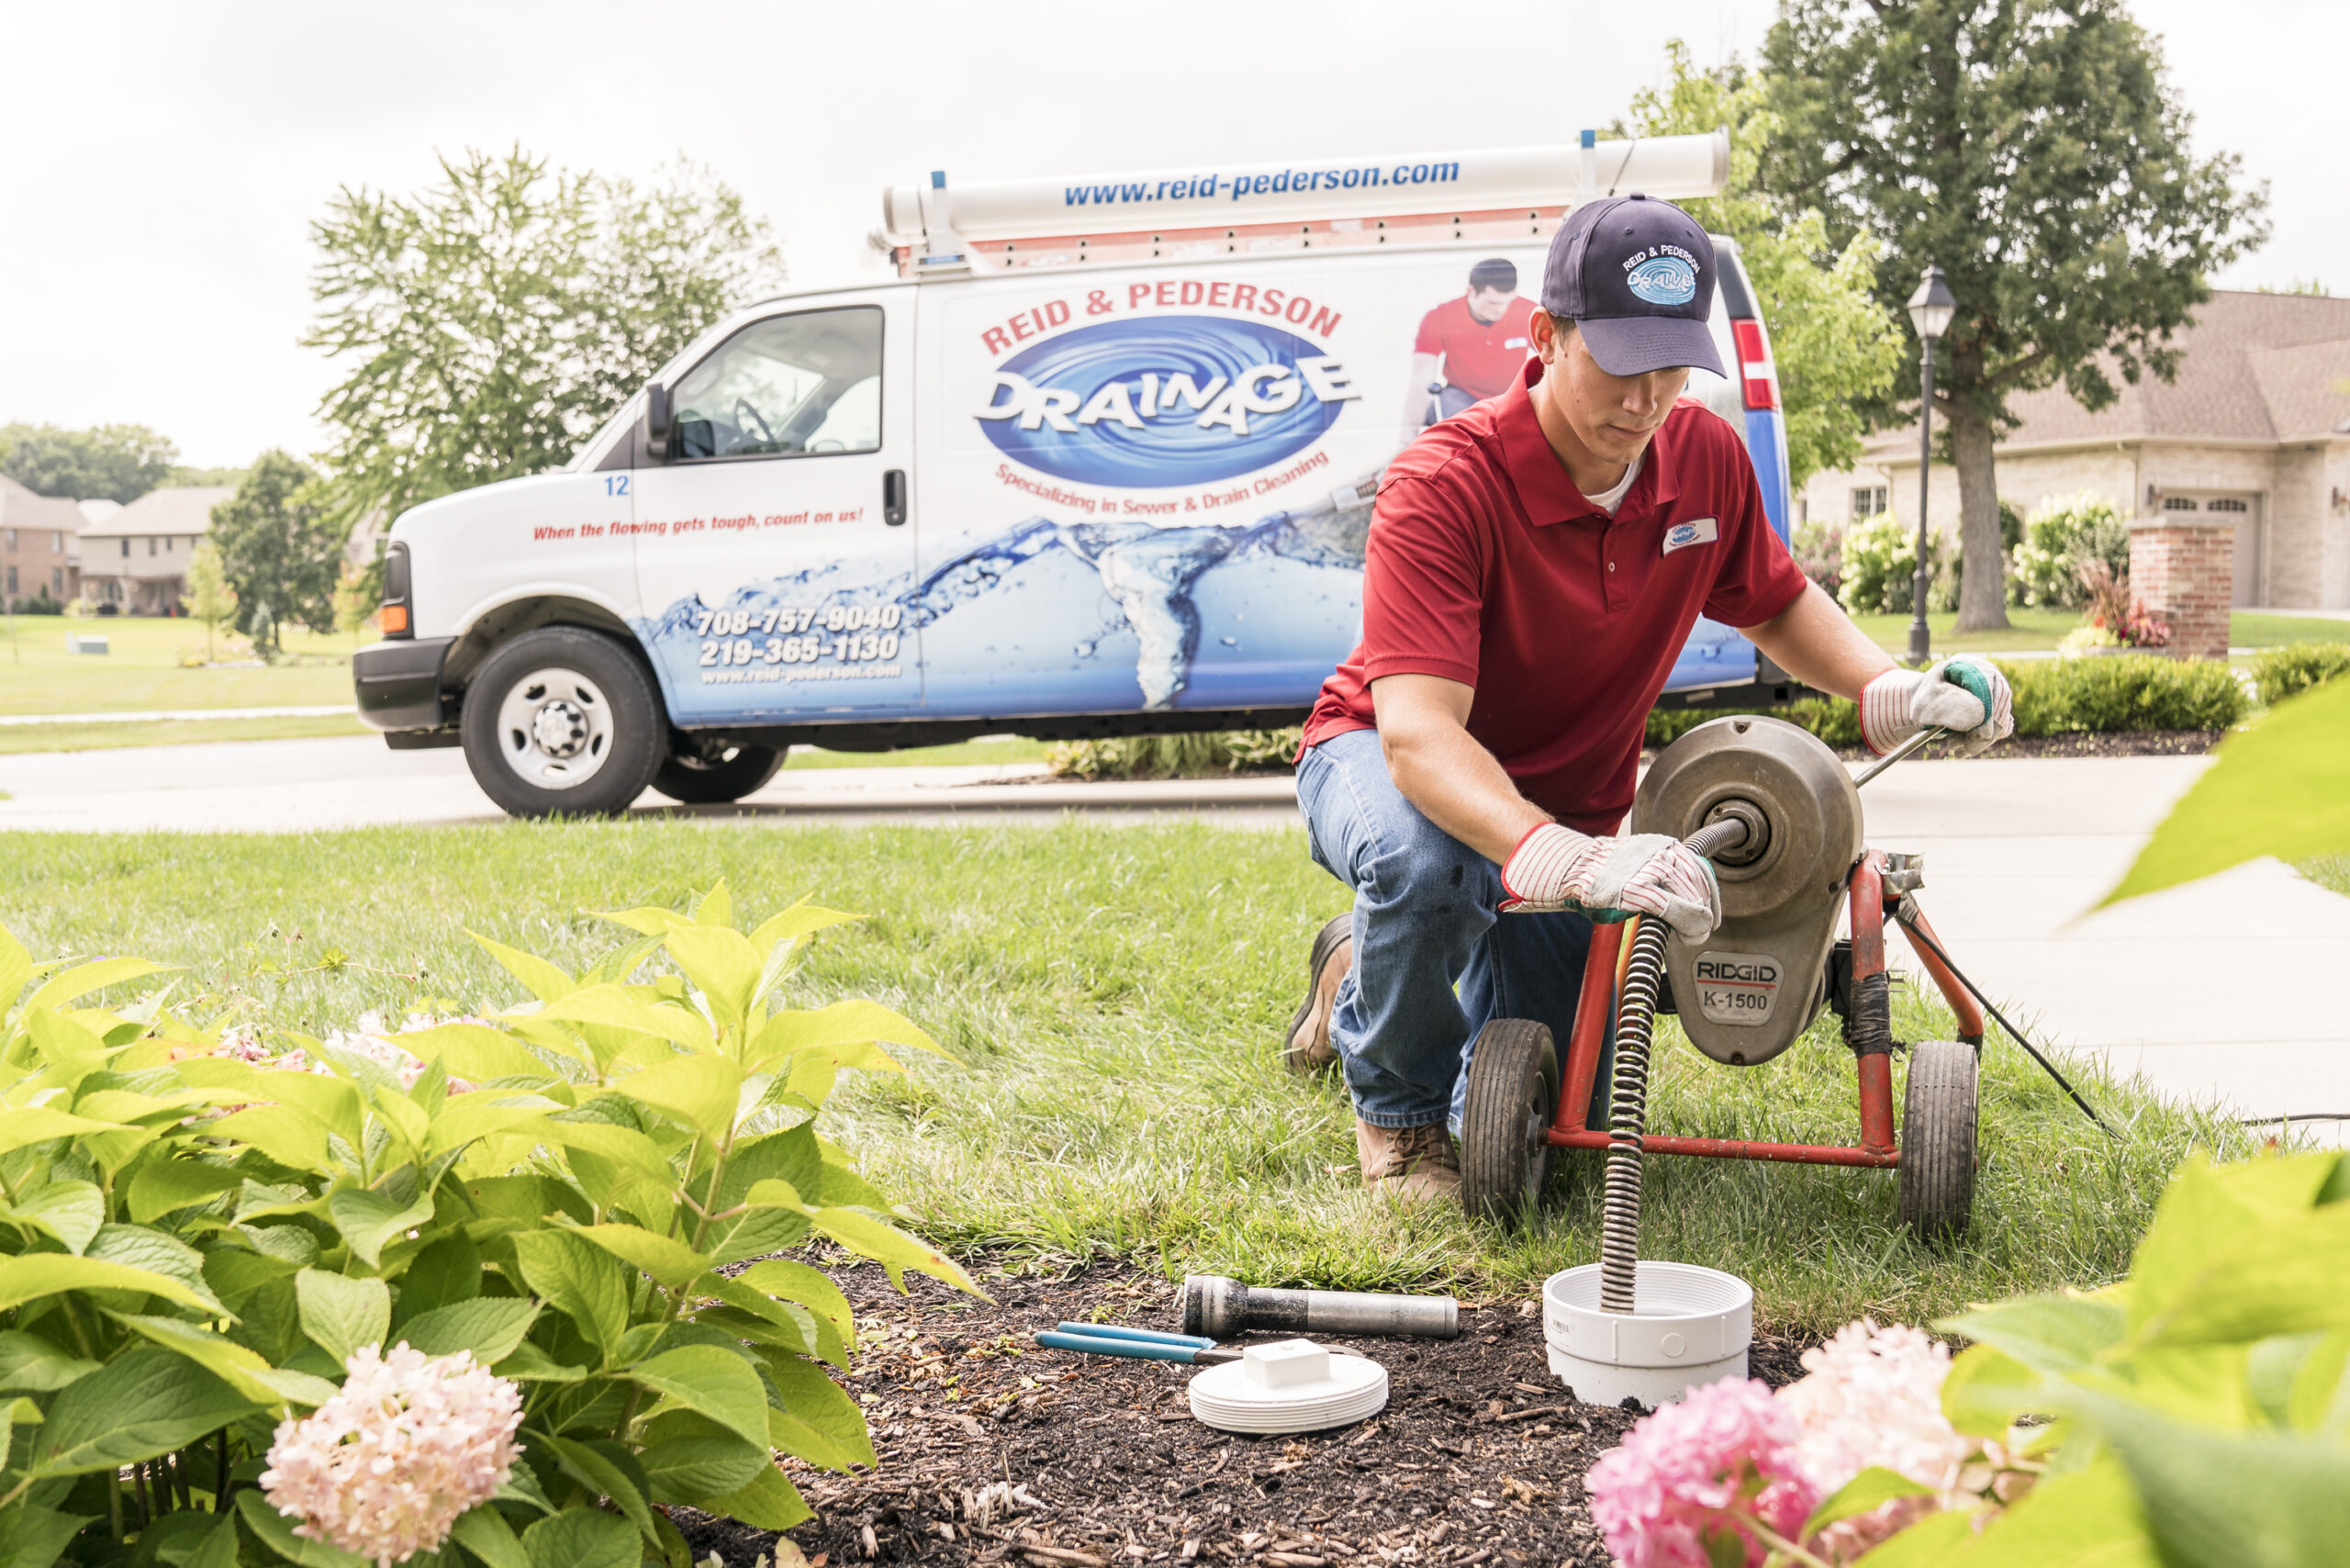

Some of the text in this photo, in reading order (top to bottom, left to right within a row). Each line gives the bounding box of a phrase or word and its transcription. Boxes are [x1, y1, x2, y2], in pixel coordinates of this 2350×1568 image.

[1065, 162, 1460, 207] www.reid-pederson.com
[1622, 245, 1700, 274] REID & PEDERSON
[981, 281, 1342, 355] REID & PEDERSON
[972, 355, 1363, 435] DRAINAGE
[604, 475, 630, 497] 12
[995, 450, 1330, 516] Specializing in Sewer & Drain Cleaning
[533, 525, 576, 541] When
[580, 523, 604, 538] the
[610, 520, 666, 537] flowing
[673, 517, 706, 535] gets
[764, 510, 810, 527] count
[814, 511, 834, 524] on
[838, 508, 865, 523] us!
[697, 602, 902, 637] 708-757-9040
[699, 633, 900, 666] 219-365-1130
[701, 663, 902, 685] www.reid-pederson.com
[1697, 961, 1777, 982] RIDGID
[1704, 991, 1768, 1010] K-1500
